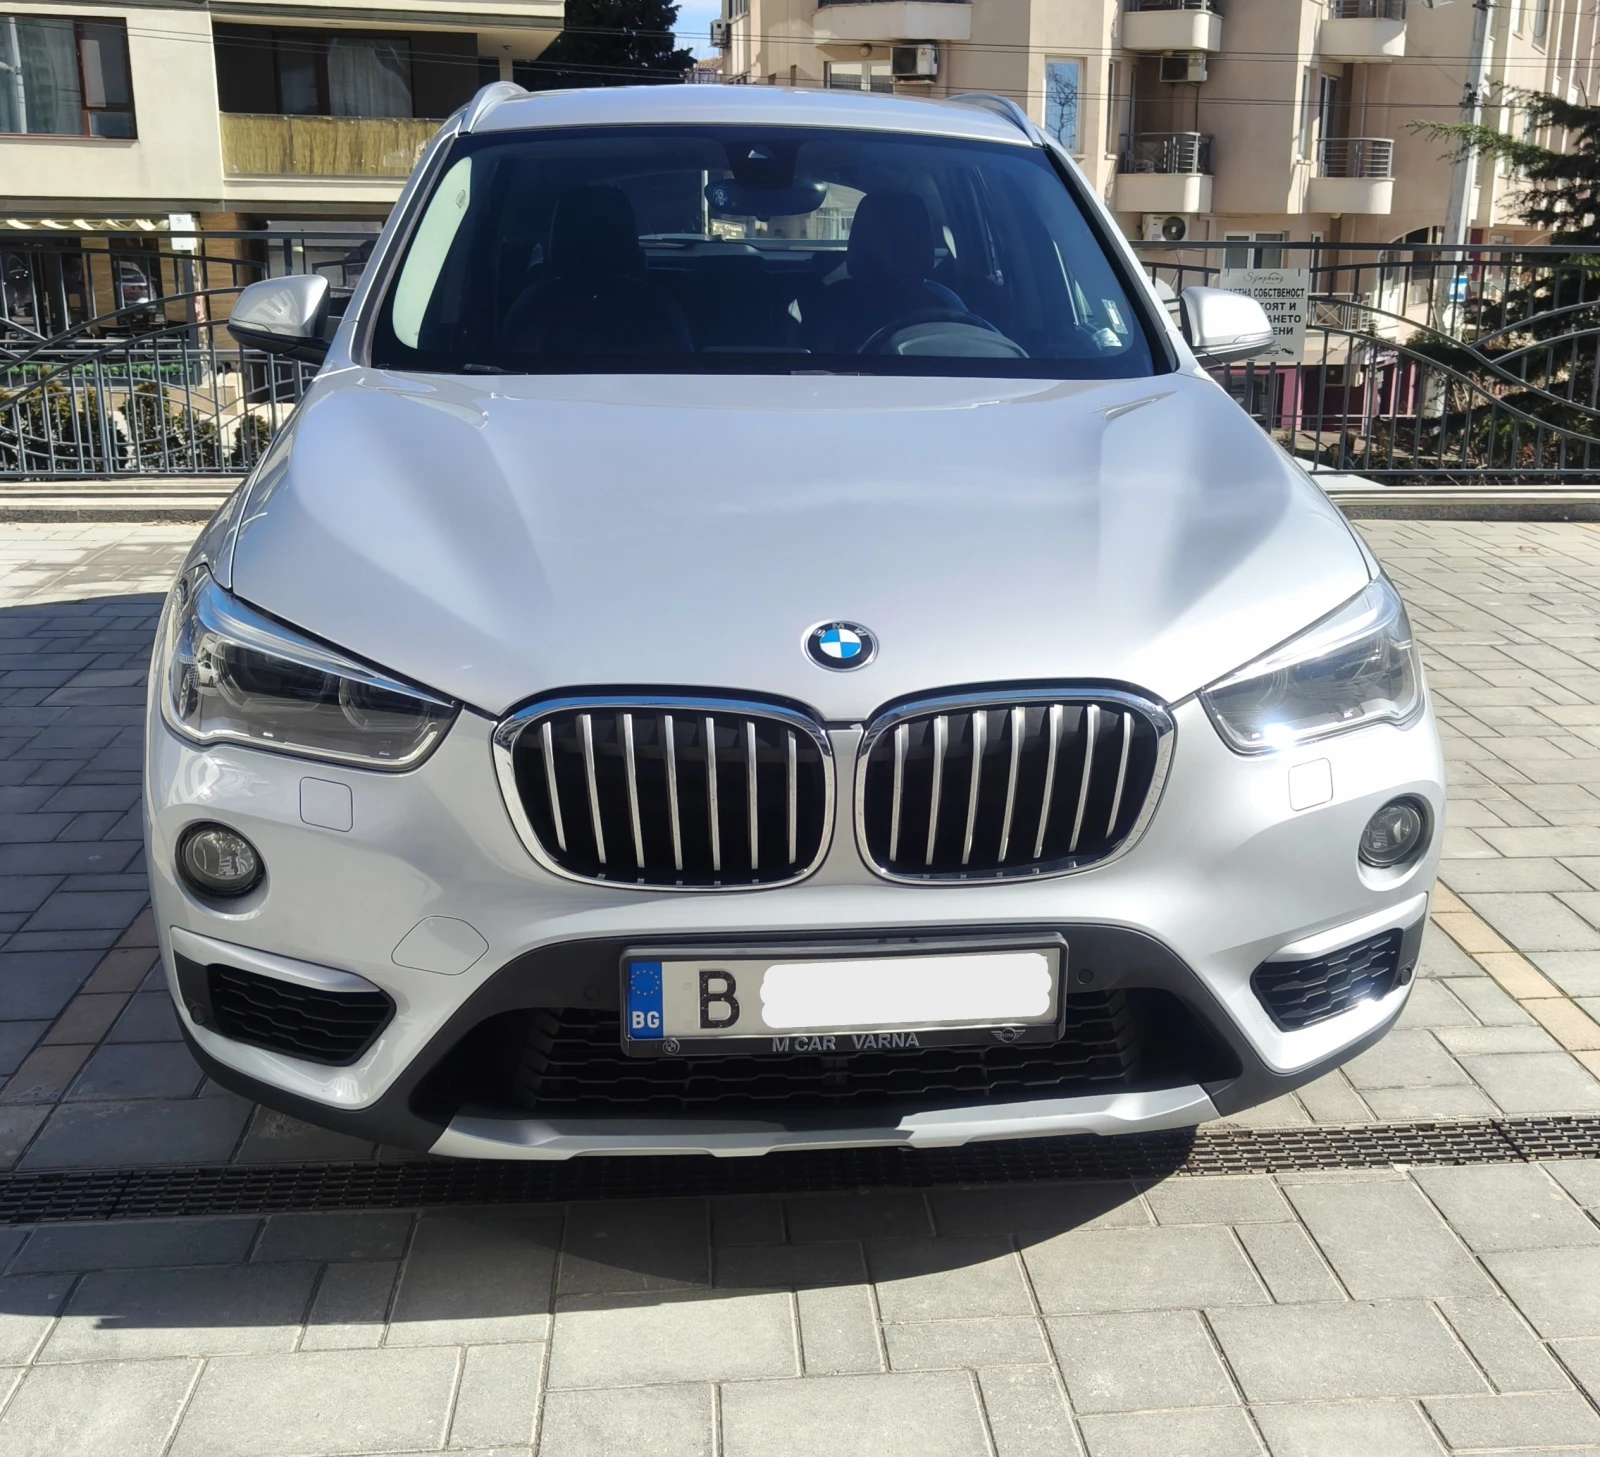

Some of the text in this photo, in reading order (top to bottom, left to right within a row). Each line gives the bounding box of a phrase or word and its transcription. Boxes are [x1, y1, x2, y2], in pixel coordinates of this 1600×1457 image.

[1243, 272, 1284, 284] Symphony
[1253, 288, 1305, 298] СОБСТВЕНОСТ
[1289, 302, 1297, 311] И
[812, 623, 868, 637] BMW
[698, 970, 740, 1029] B
[631, 1010, 660, 1029] BG
[772, 1032, 920, 1052] M CAR VARNA
